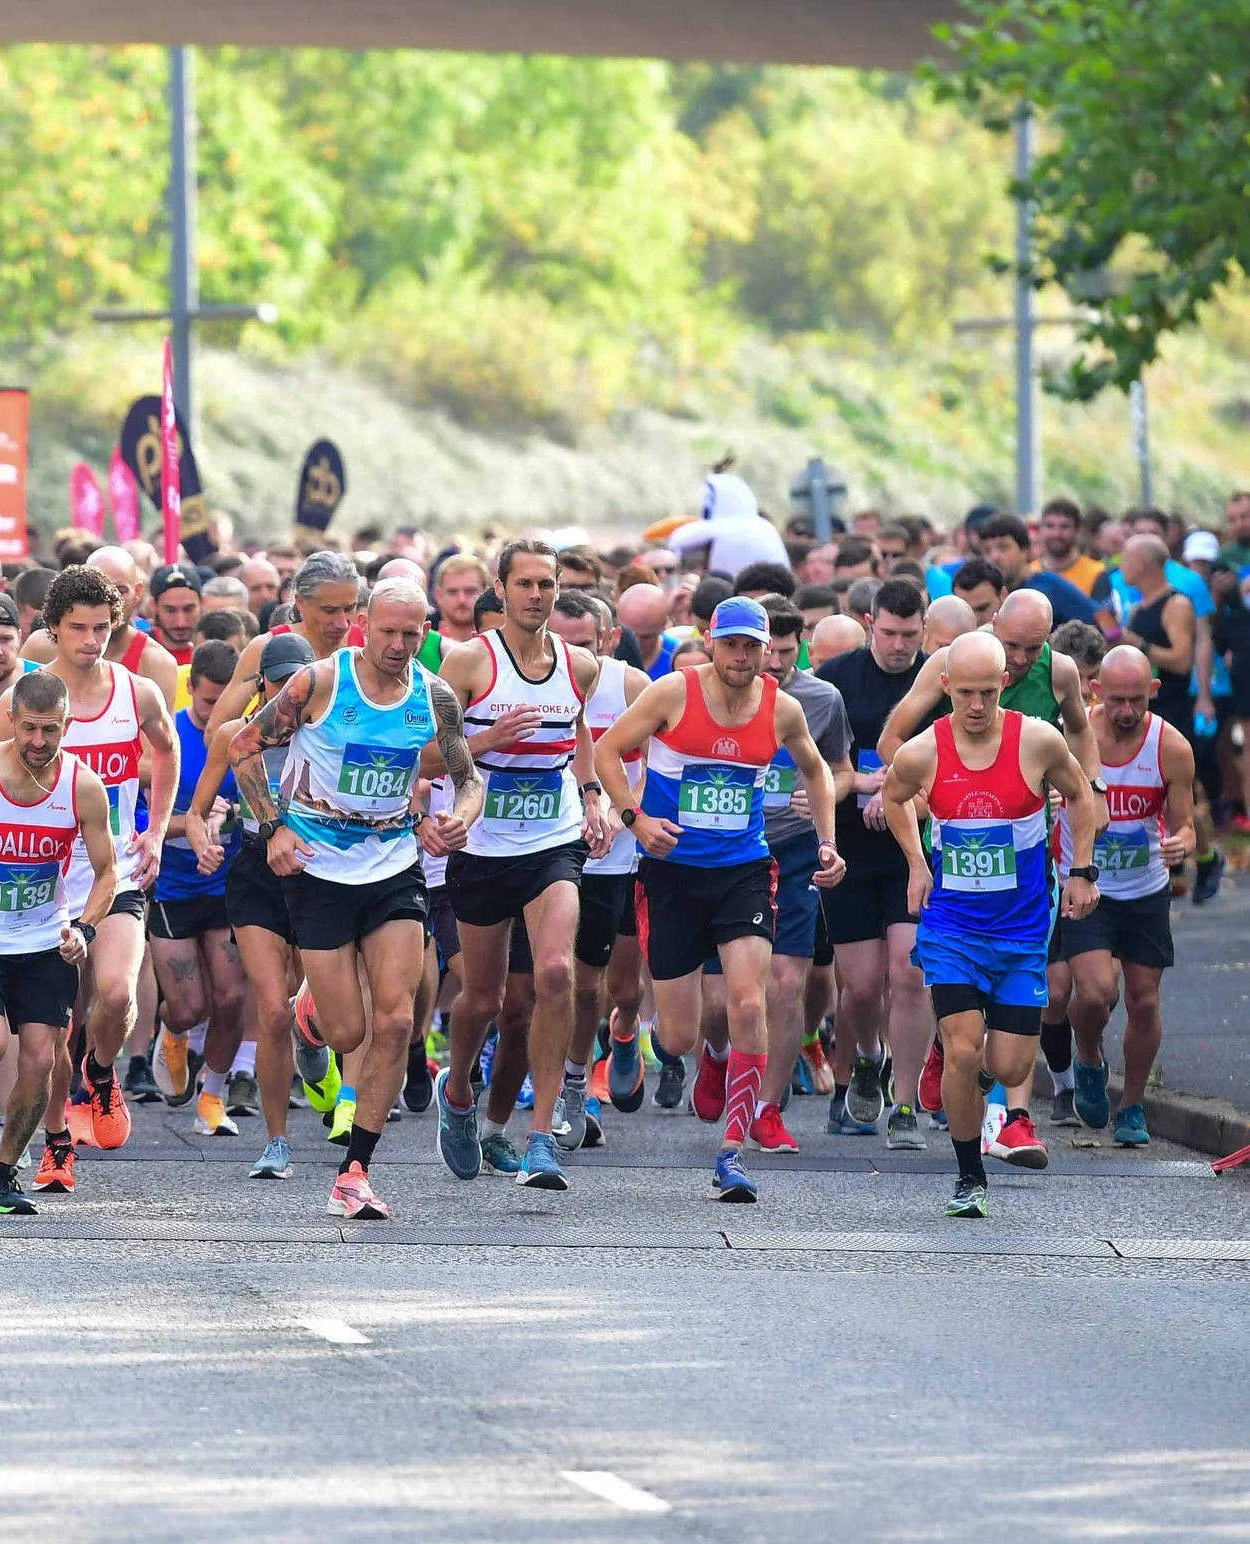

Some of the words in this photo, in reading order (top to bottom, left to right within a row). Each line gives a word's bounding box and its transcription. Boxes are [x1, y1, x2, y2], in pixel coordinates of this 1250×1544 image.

[490, 703, 512, 712] CITY
[537, 704, 562, 714] TOKE
[348, 769, 406, 797] 1084
[493, 794, 555, 819] 1260
[688, 786, 747, 814] 1385
[948, 849, 1006, 877] 1391
[1094, 850, 1138, 870] 547
